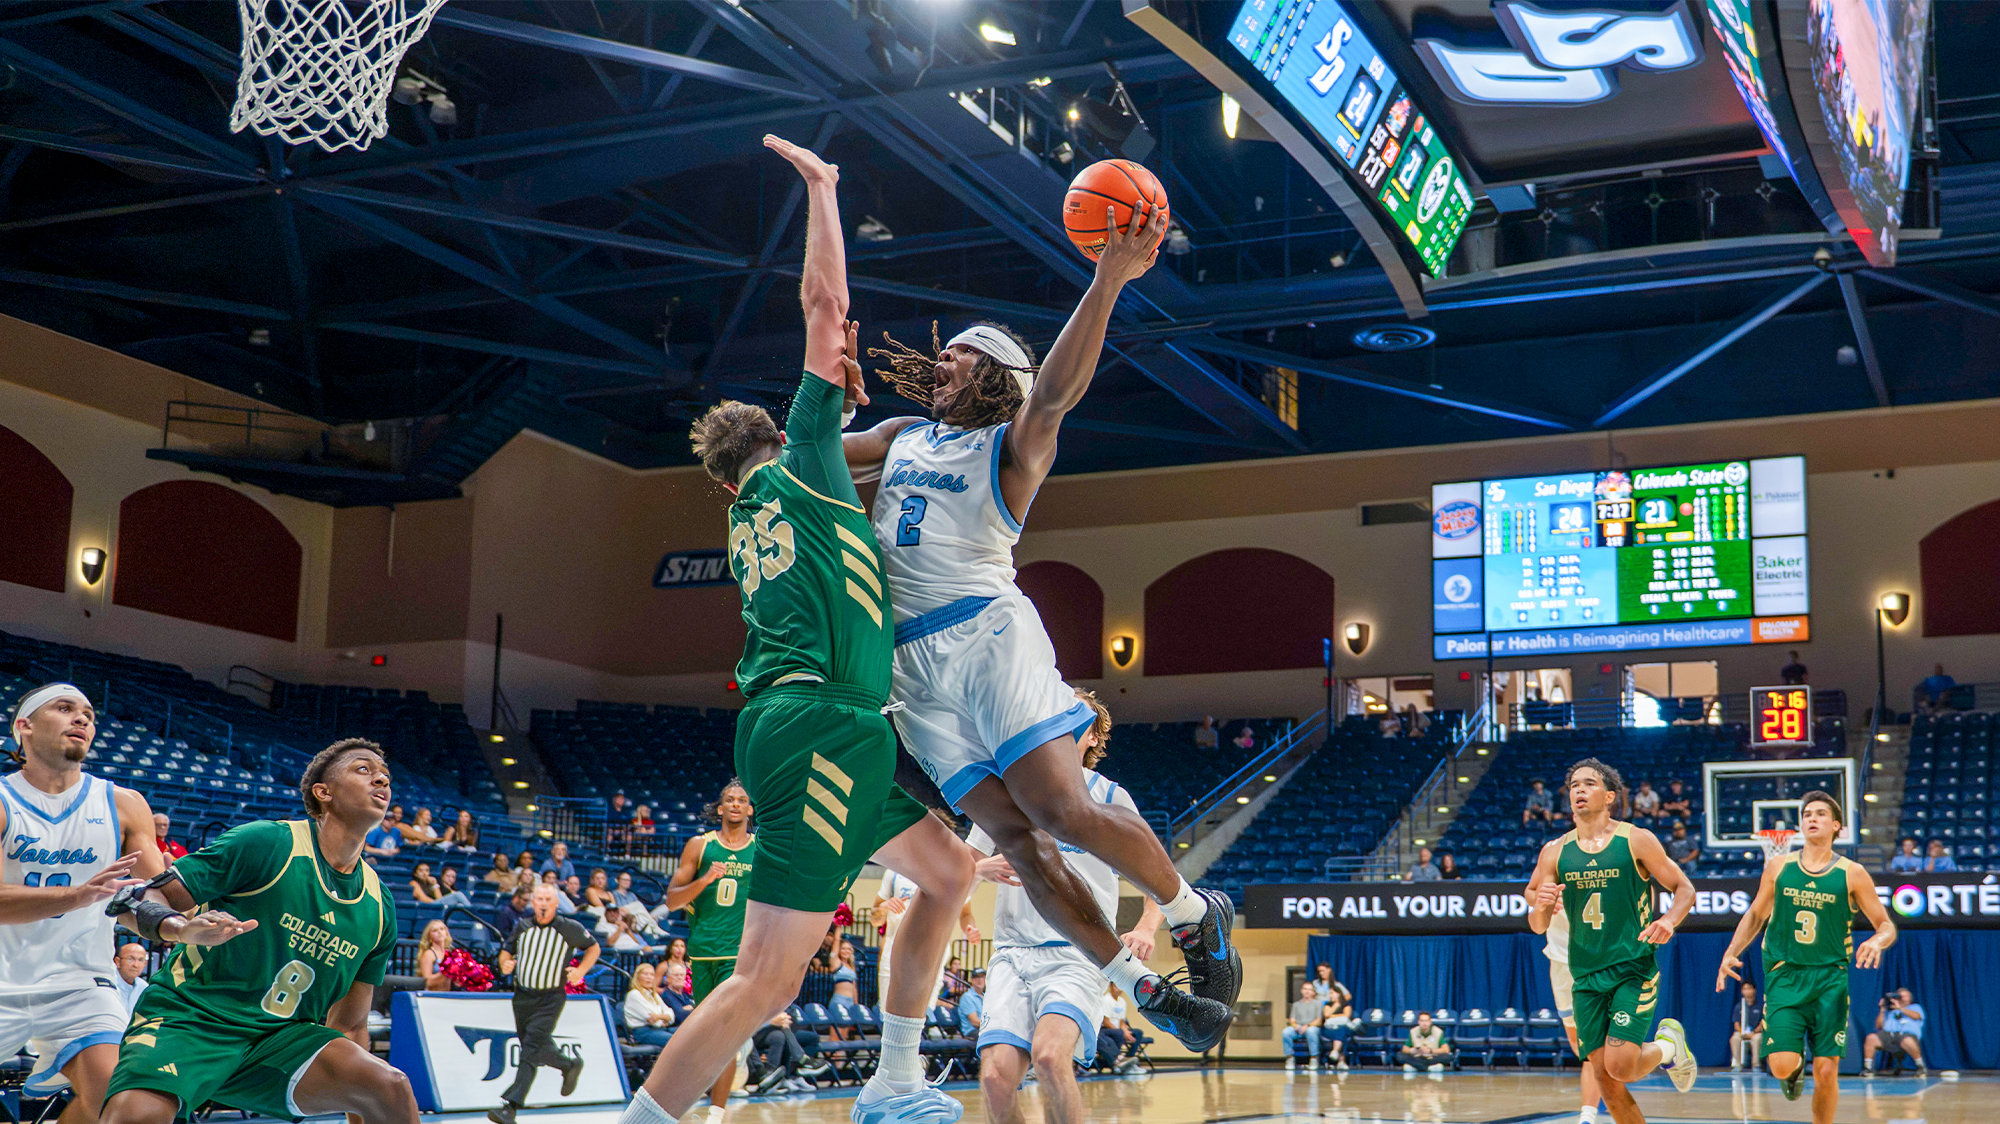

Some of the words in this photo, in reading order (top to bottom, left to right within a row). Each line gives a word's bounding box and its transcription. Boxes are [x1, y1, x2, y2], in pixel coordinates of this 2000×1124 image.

[1344, 81, 1374, 127] 24
[1359, 147, 1387, 189] 7:17
[1398, 149, 1423, 191] 21
[885, 459, 969, 493] Toreros
[1534, 482, 1558, 497] San
[1558, 480, 1593, 498] Diego
[1634, 470, 1689, 490] Colorado
[1688, 469, 1725, 486] State
[896, 495, 929, 547] 2
[1436, 507, 1477, 523] Jersey
[1558, 506, 1583, 530] 24
[1597, 503, 1630, 520] 7:17
[1645, 500, 1668, 523] 21
[731, 498, 796, 602] 35
[1756, 555, 1803, 569] Baker
[660, 556, 728, 583] SAN
[1756, 570, 1804, 581] Electric
[1762, 620, 1800, 630] PALOMAR
[1508, 633, 1556, 650] Health
[1559, 634, 1570, 647] is
[1573, 630, 1660, 649] Reimagining
[1768, 691, 1807, 709] 7:16
[1762, 709, 1804, 740] 28
[7, 834, 98, 865] Toreros
[1565, 868, 1620, 882] COLORADO
[1576, 879, 1608, 889] STATE
[716, 878, 738, 907] 0
[1282, 896, 1334, 919] FOR
[1339, 896, 1388, 919] ALL
[1393, 895, 1467, 918] YOUR
[1472, 894, 1535, 917] AUD
[1659, 890, 1751, 915] NEDS
[1783, 886, 1836, 903] COLORADO
[1792, 896, 1824, 910] STATE
[1582, 892, 1605, 930] 4
[279, 912, 359, 960] COLORADO
[1794, 910, 1817, 944] 3
[288, 933, 340, 968] STATE
[261, 959, 316, 1018] 8
